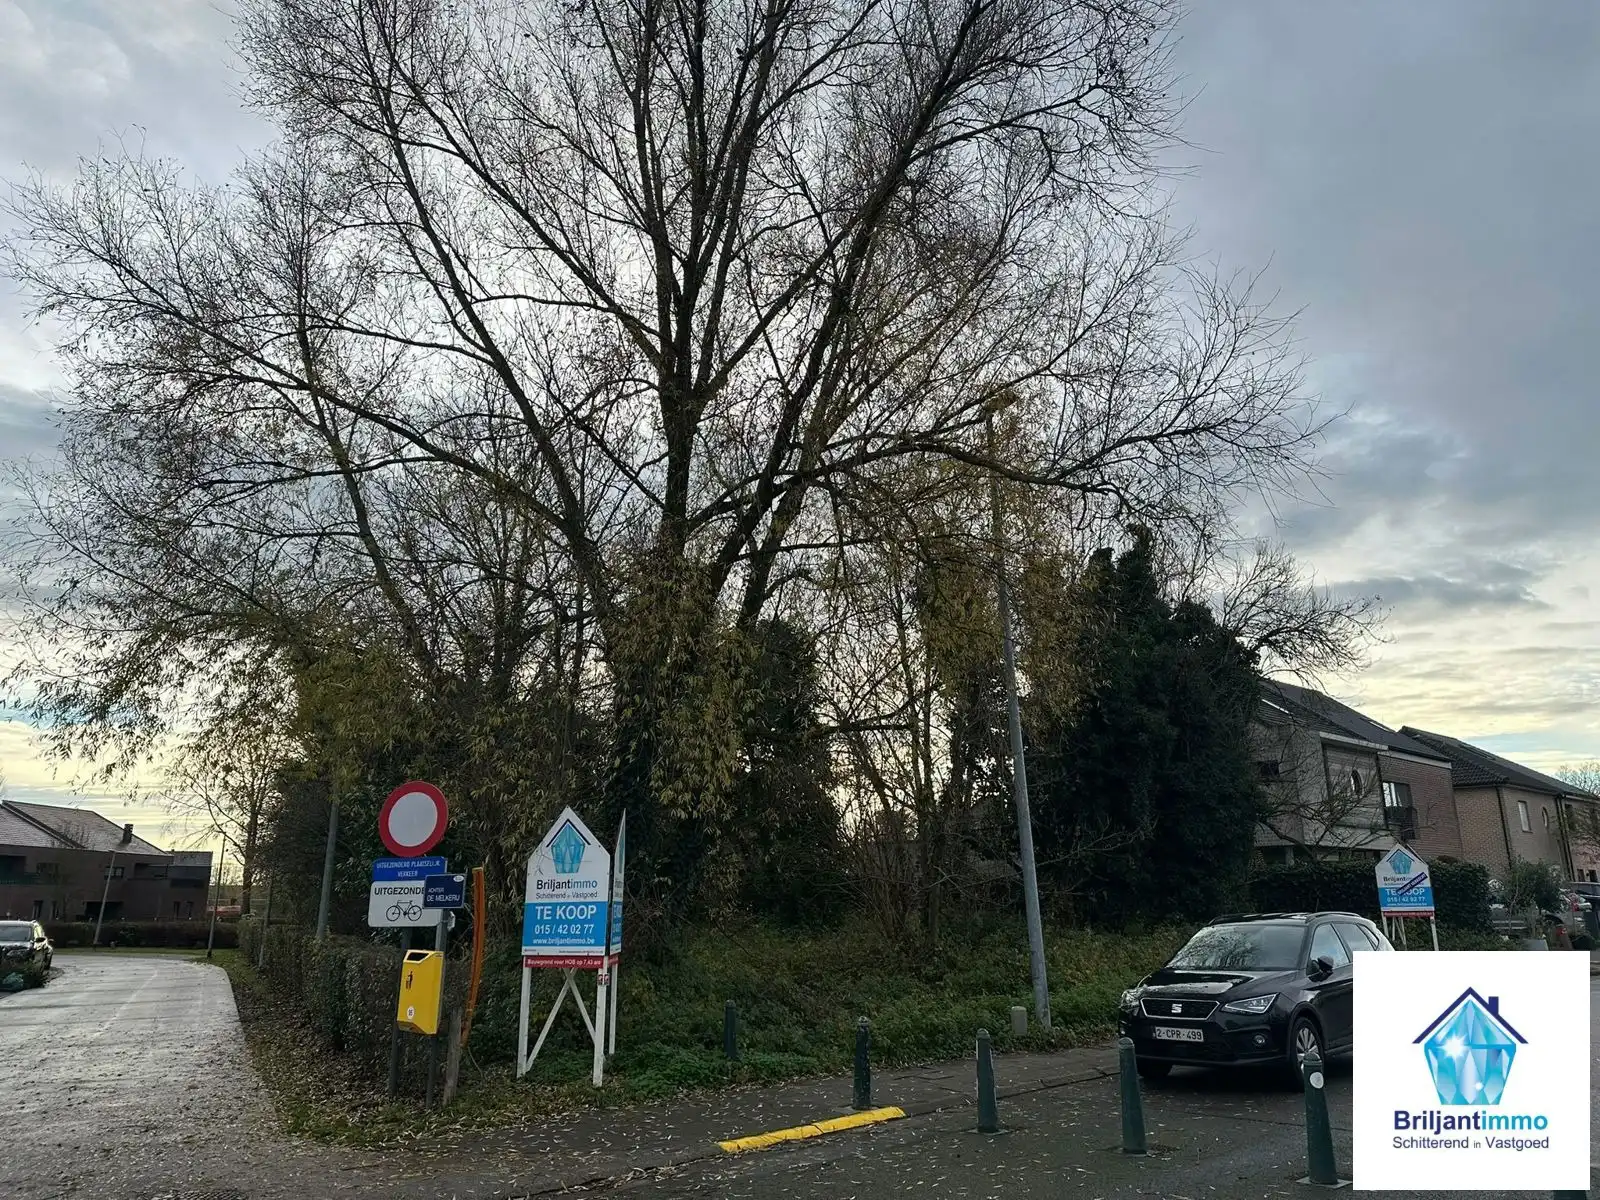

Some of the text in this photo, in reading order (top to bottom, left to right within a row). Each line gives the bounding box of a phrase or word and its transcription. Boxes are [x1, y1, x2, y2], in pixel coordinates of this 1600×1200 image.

[536, 879, 598, 892] Briljantimmo
[535, 892, 567, 900] Schitterend
[572, 891, 598, 899] Vastgoed
[1385, 888, 1396, 896] TE
[435, 894, 460, 902] MELKERIJ
[535, 906, 552, 920] TE
[555, 905, 597, 920] KOOP
[534, 925, 550, 935] 015
[557, 924, 568, 934] 42
[570, 924, 581, 934] 02
[583, 924, 594, 934] 77
